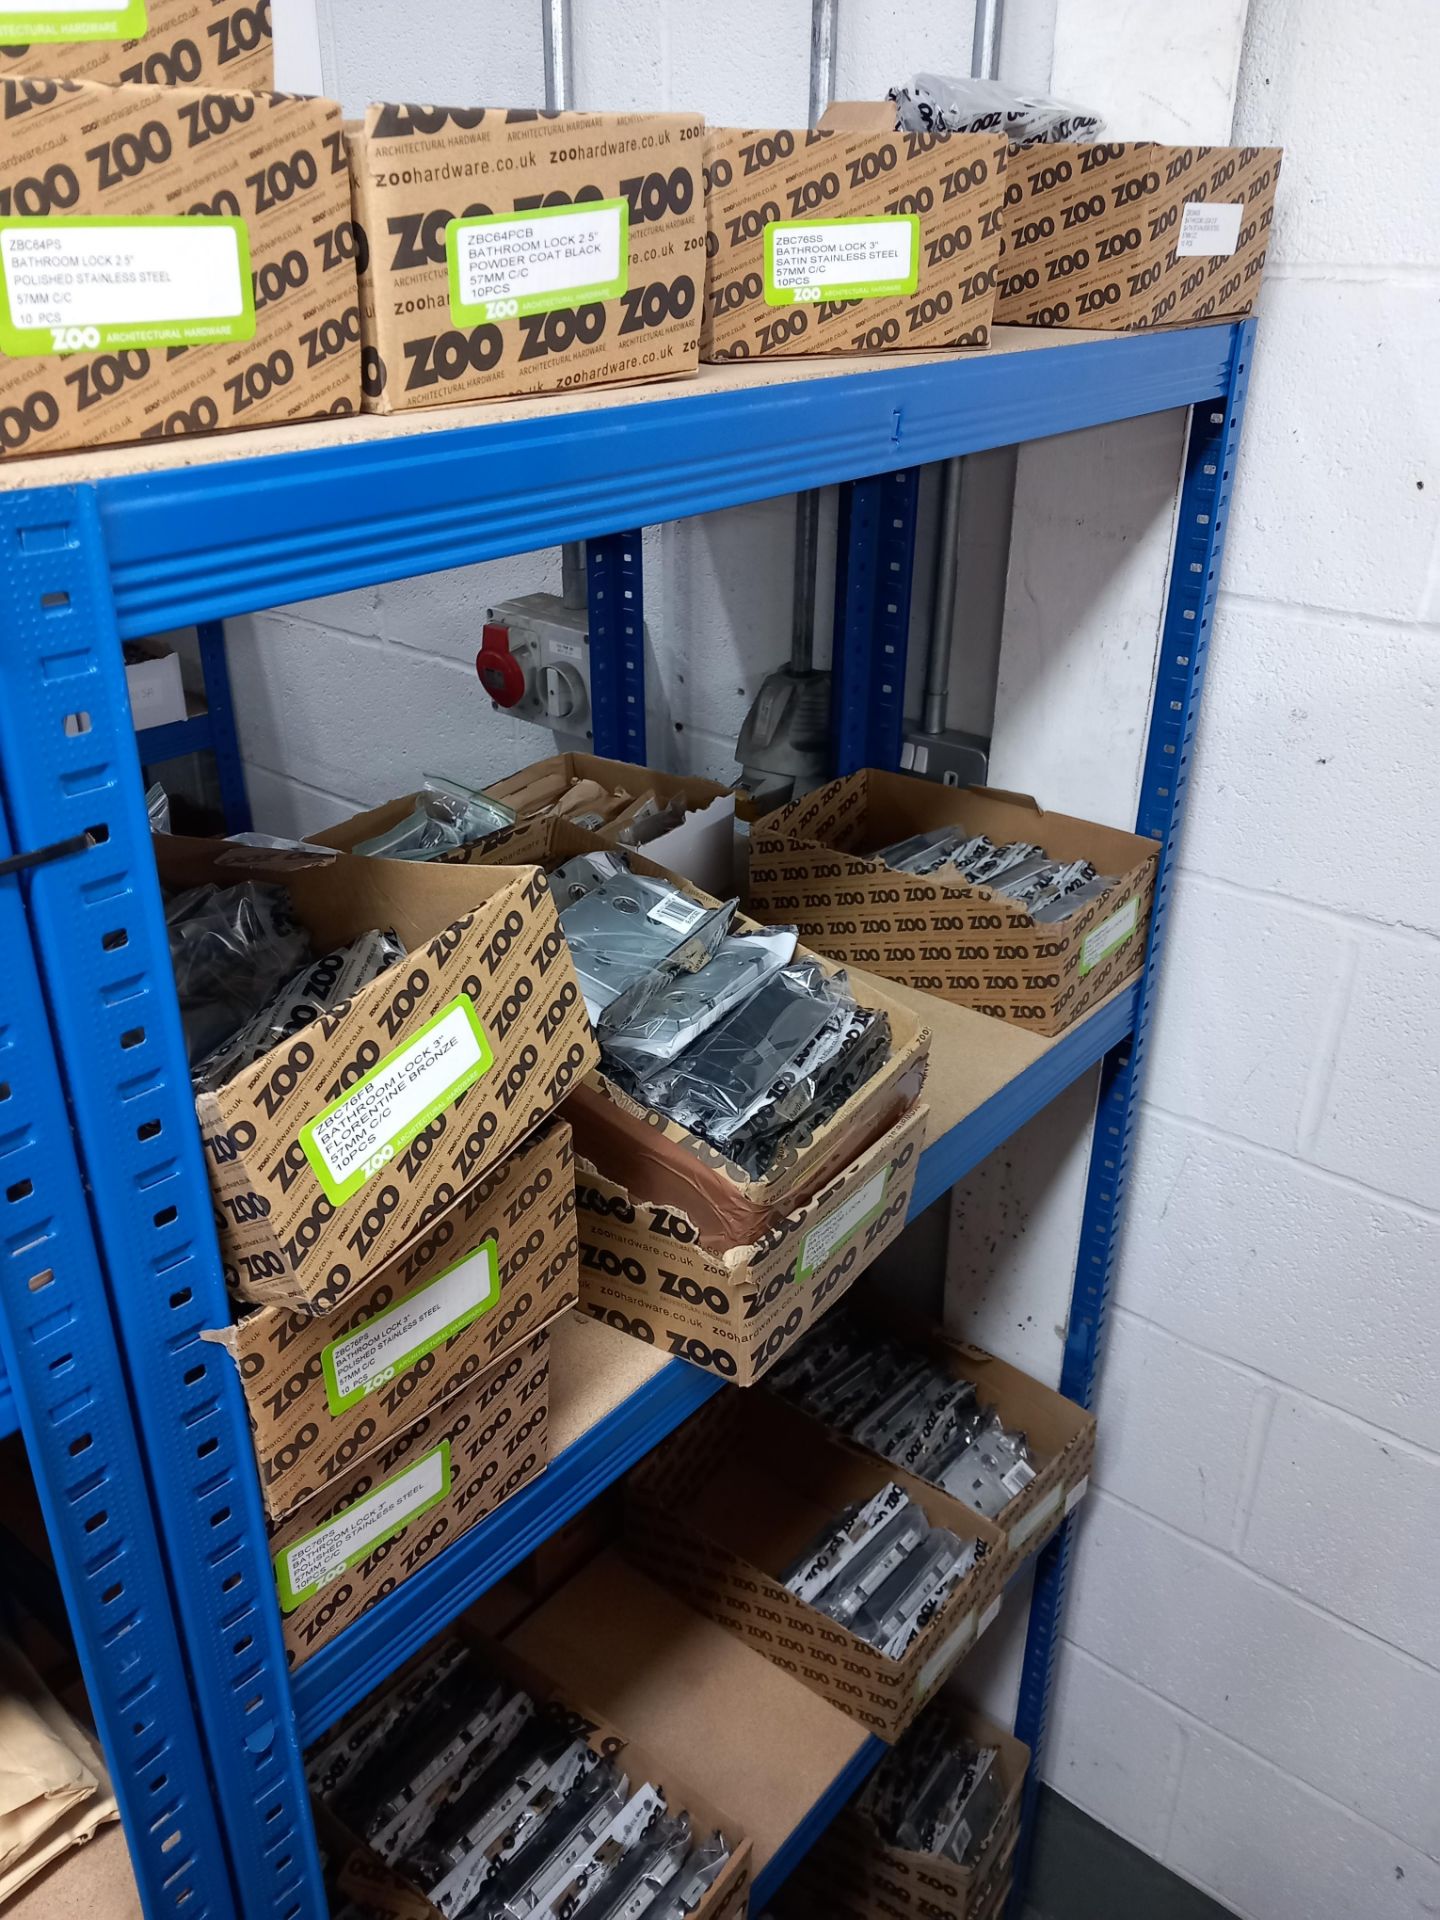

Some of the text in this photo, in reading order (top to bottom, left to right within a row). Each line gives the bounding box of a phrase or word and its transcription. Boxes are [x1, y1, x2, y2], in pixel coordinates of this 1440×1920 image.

[178, 95, 254, 148] ZOO
[507, 116, 603, 142] ARCHITECTURAL HARDWARE
[86, 121, 172, 191] ZOO
[376, 131, 490, 157] ARCHITECTURAL HARDWARE
[549, 130, 671, 163] zoohardware.co.uk
[739, 130, 794, 176] ZOO
[246, 150, 317, 215] ZOO
[375, 152, 537, 187] zoohardware.co.uk
[846, 144, 897, 189] ZOO
[940, 159, 987, 203] ZOO
[1028, 161, 1072, 196] ZOO
[620, 167, 693, 226] ZOO
[787, 172, 840, 217] ZOO
[1111, 172, 1160, 208] ZOO
[1060, 195, 1105, 230] ZOO
[1148, 205, 1177, 242] ZOO
[10, 239, 62, 251] ZBC64PS
[468, 228, 533, 245] ZBC64PCB
[469, 241, 540, 259] BATHROOM
[544, 236, 575, 249] LOCK
[469, 244, 601, 271] POWDER COAT BLACK
[776, 235, 823, 245] ZBC76SS
[776, 241, 879, 256] BATHROOM LOCK 3"
[924, 225, 972, 267] ZOO
[1096, 228, 1141, 262] ZOO
[12, 256, 79, 269] BATHROOM
[82, 255, 113, 267] LOCK
[14, 271, 171, 285] POLISHED STAINLESS STEEL
[471, 268, 529, 285] 57MM C/C
[776, 250, 898, 266] SATIN STAINLESS STEEL
[776, 265, 826, 277] 57MM C/C
[1045, 249, 1089, 282] ZOO
[17, 292, 72, 305] 57MM C/C
[472, 283, 511, 298] 10PCS
[777, 277, 810, 287] 10PCS
[794, 287, 820, 302] ZOO
[997, 269, 1039, 300] ZOO
[20, 313, 62, 325] 10 PCS
[486, 300, 518, 320] ZOO
[618, 275, 695, 336] ZOO
[906, 291, 952, 332] ZOO
[51, 325, 232, 350] ZOO ARCHITECTURAL HARDWARE
[518, 302, 606, 362] ZOO
[619, 318, 696, 349] ARCHITECTURAL HARDWARE
[404, 323, 503, 391] ZOO
[519, 343, 606, 376] ARCHITECTURAL HARDWARE
[556, 345, 674, 389] zoohardware.co.uk
[65, 348, 150, 412] ZOO
[224, 350, 294, 415] ZOO
[407, 370, 505, 406] ARCHITECTURAL HARDWARE
[904, 887, 936, 901] ZOO
[479, 910, 523, 976] ZOO
[931, 917, 963, 930] ZOO
[303, 954, 344, 1002] ZOO
[430, 955, 473, 1016] zoohardware.co.uk
[1022, 974, 1060, 989] ZOO
[377, 969, 429, 1040] ZOO
[489, 976, 533, 1042] ZOO
[536, 982, 577, 1045] ZOO
[315, 1024, 365, 1092] zoohardware.co.uk
[253, 1042, 314, 1120] ZOO
[321, 1035, 444, 1144] BATHROOM LOCK 3"
[325, 1036, 459, 1154] FLORENTINE BRONZE
[316, 1083, 374, 1135] ZBC76FB
[362, 1069, 479, 1180] ZOO ARCHITECTURAL HARDWARE
[257, 1100, 311, 1172] zoohardware.co.uk
[330, 1108, 392, 1164] 57MM C/C
[336, 1134, 377, 1171] 10PCS
[452, 1112, 497, 1181] ZOO
[337, 1171, 384, 1241] zoohardware.co.uk
[401, 1164, 444, 1231] zoohardware.co.uk
[503, 1168, 552, 1228] ZOO
[591, 1227, 693, 1267] zoohardware.co.uk
[658, 1268, 729, 1314] ZOO
[812, 1247, 856, 1310] ZOO
[600, 1286, 702, 1328] zoohardware.co.uk
[335, 1333, 369, 1359] ZBC76PS
[336, 1334, 381, 1367] BATHROOM
[382, 1320, 402, 1338] LOCK
[337, 1304, 441, 1377] POLISHED STAINLESS STEEL
[666, 1330, 737, 1376] ZOO
[339, 1358, 376, 1386] 57MM C/C
[363, 1366, 394, 1394] ZOO
[397, 1330, 448, 1368] ARCHITECTURAL
[381, 1351, 434, 1408] ZOO
[263, 1351, 323, 1420] ZOO
[341, 1373, 369, 1395] 10 PCS
[465, 1408, 511, 1462] ZOO
[503, 1406, 547, 1459] ZOO
[262, 1423, 319, 1485] ZOO
[292, 1528, 349, 1569] BATHROOM
[350, 1511, 377, 1530] LOCK
[292, 1529, 335, 1559] ZBC76PS
[293, 1540, 343, 1577] POLISHED
[345, 1505, 395, 1541] STAINLESS
[397, 1484, 424, 1506] STEEL
[400, 1518, 448, 1574] ZOO
[295, 1550, 341, 1584] 57MM C/C
[297, 1566, 327, 1590] 10PCS
[315, 1562, 347, 1590] ZOO
